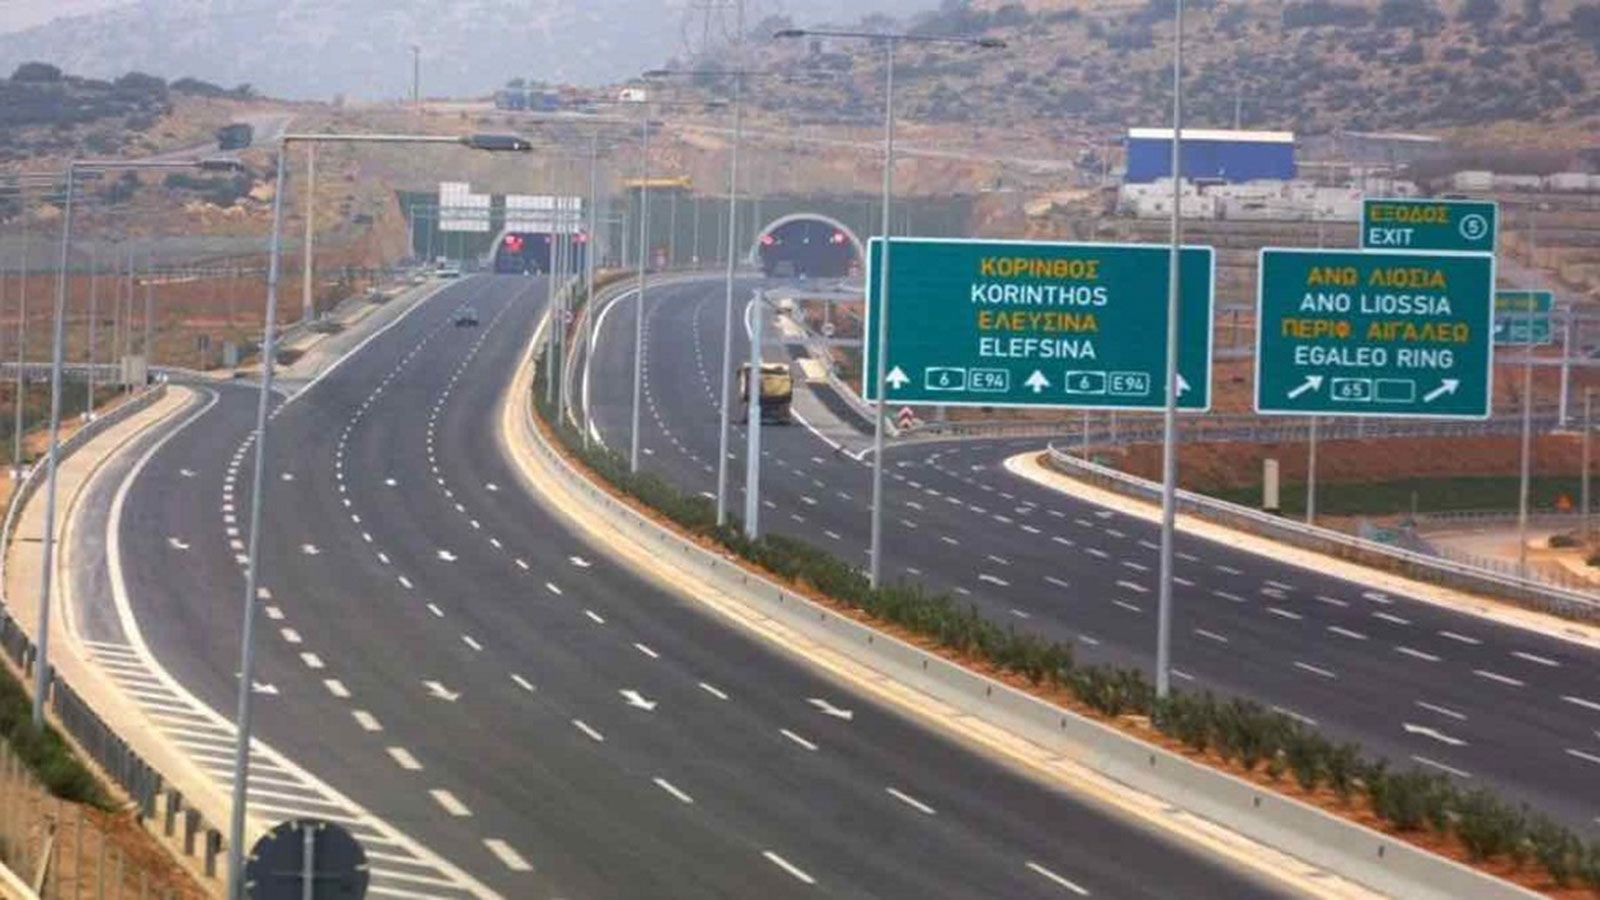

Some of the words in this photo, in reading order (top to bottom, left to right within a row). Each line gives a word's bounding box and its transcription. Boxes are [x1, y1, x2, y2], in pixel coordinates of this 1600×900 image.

[1370, 204, 1449, 224] ΕΞΟΔΟΣ
[1369, 228, 1414, 245] EXIT
[1467, 219, 1479, 234] 5
[980, 257, 1100, 279] ΚΟΡΙΝΘΟΣ
[1308, 267, 1357, 286] ΑΝΩ
[1369, 267, 1446, 288] ΛΙΟΣΙΑ
[971, 284, 1108, 306] KORINTHOS
[1300, 293, 1351, 313] ANO
[1361, 294, 1452, 315] LIOSSIA
[978, 310, 1099, 333] ΕΛΕΥΣΙΝΑ
[1367, 321, 1470, 343] ΑΙΓΑΛΕΩ
[979, 337, 1097, 360] ELEFSINA
[1295, 346, 1388, 367] EGALEO
[1397, 349, 1454, 369] RING
[939, 373, 950, 387] 6
[1079, 376, 1090, 391] 6
[1341, 382, 1363, 397] 65
